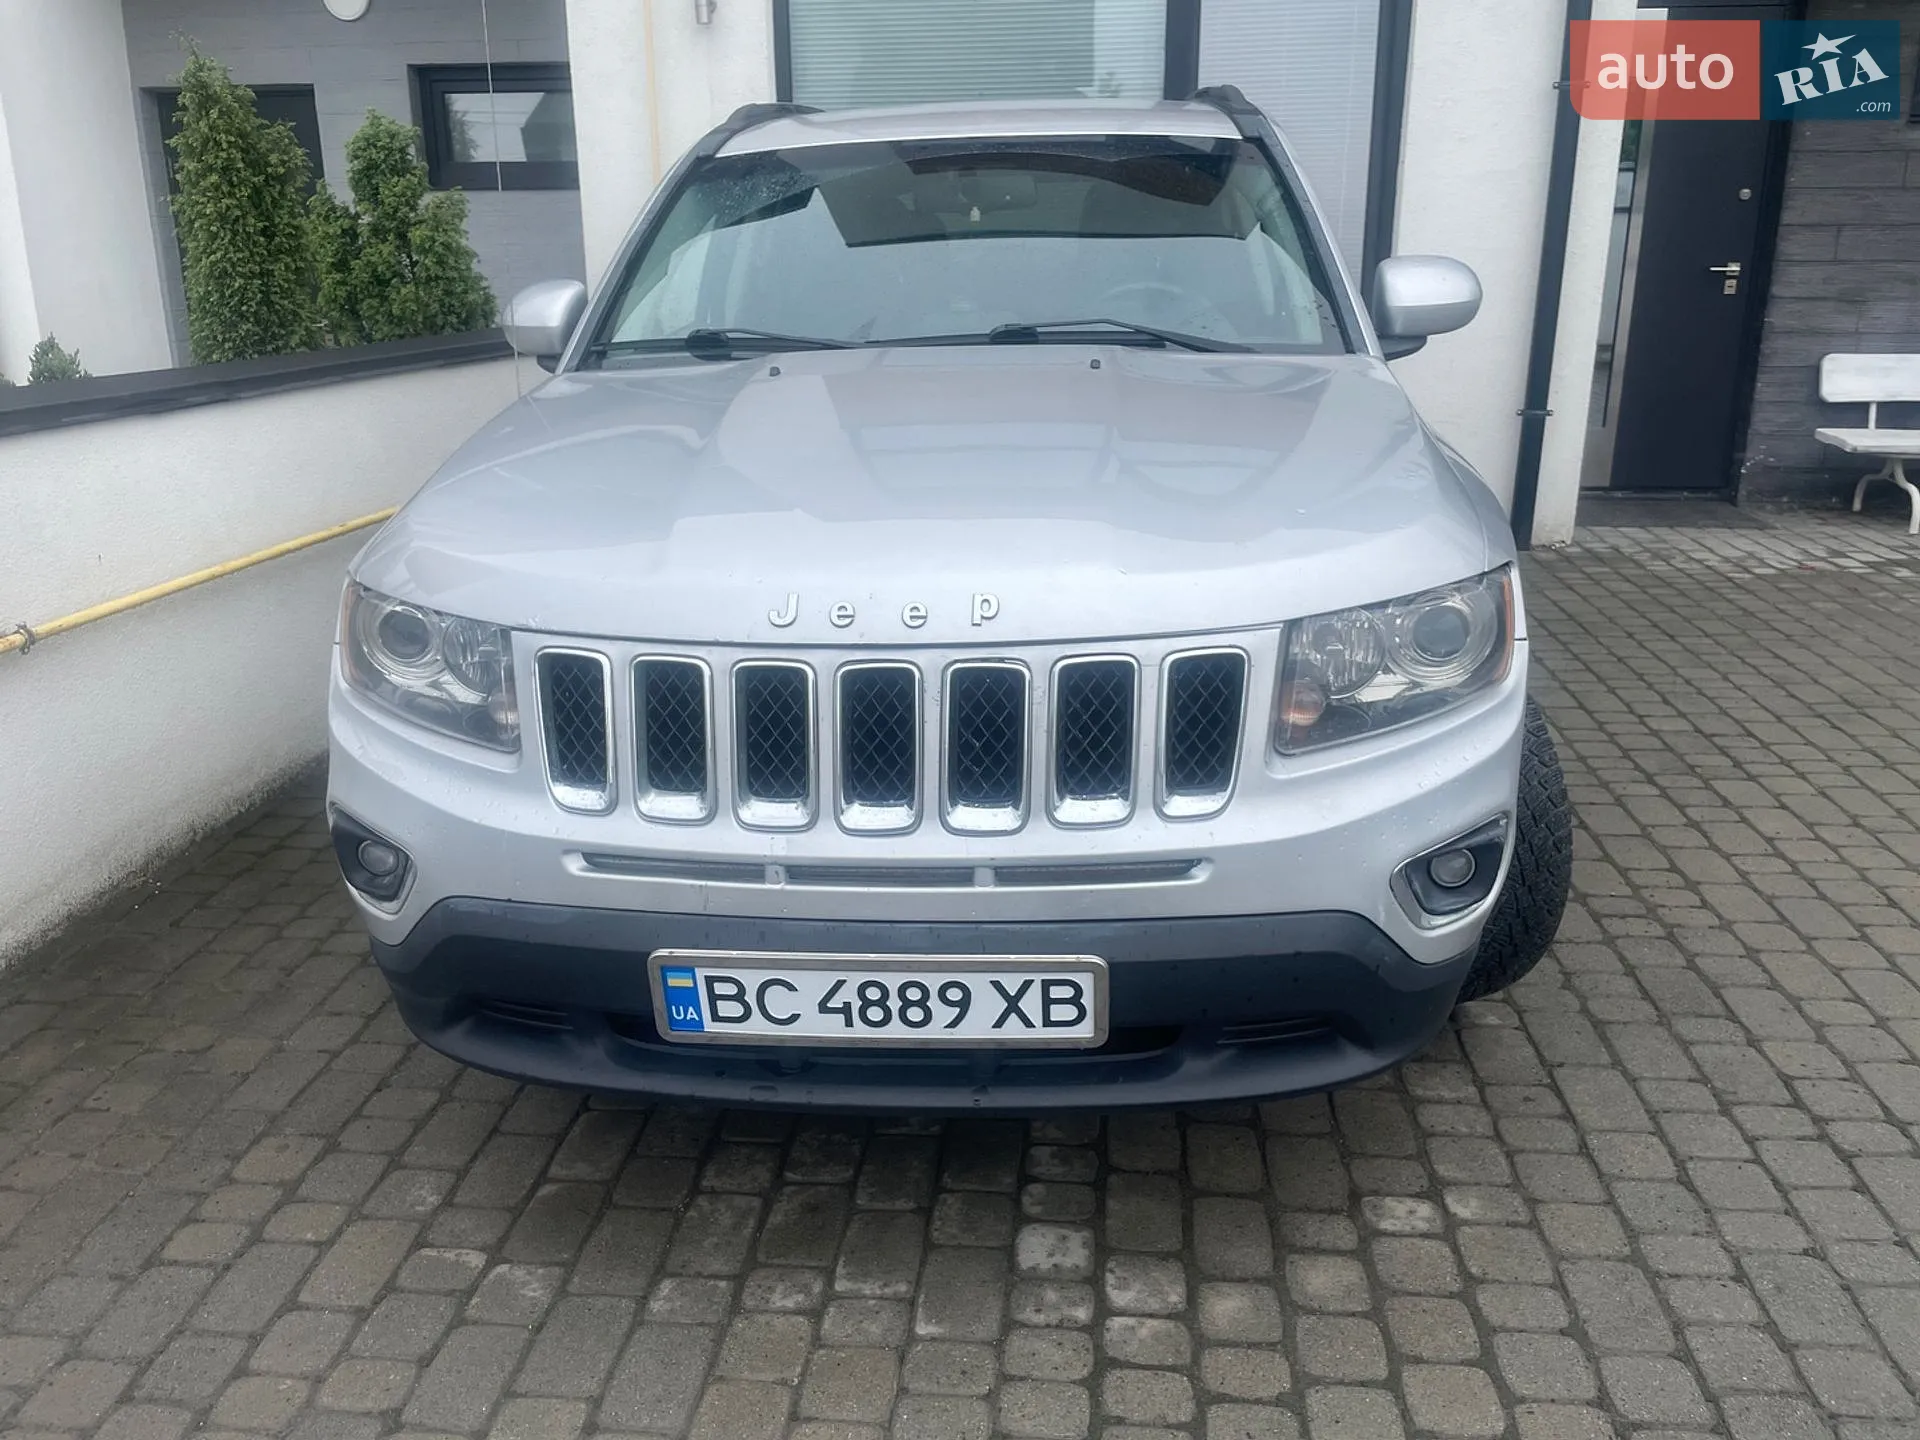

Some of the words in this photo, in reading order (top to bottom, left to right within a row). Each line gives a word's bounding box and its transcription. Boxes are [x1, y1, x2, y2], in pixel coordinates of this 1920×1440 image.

[767, 592, 1000, 629] Jeep
[671, 1005, 699, 1022] UA
[704, 974, 802, 1027] BC
[817, 978, 972, 1029] 4889
[988, 979, 1088, 1029] XB
